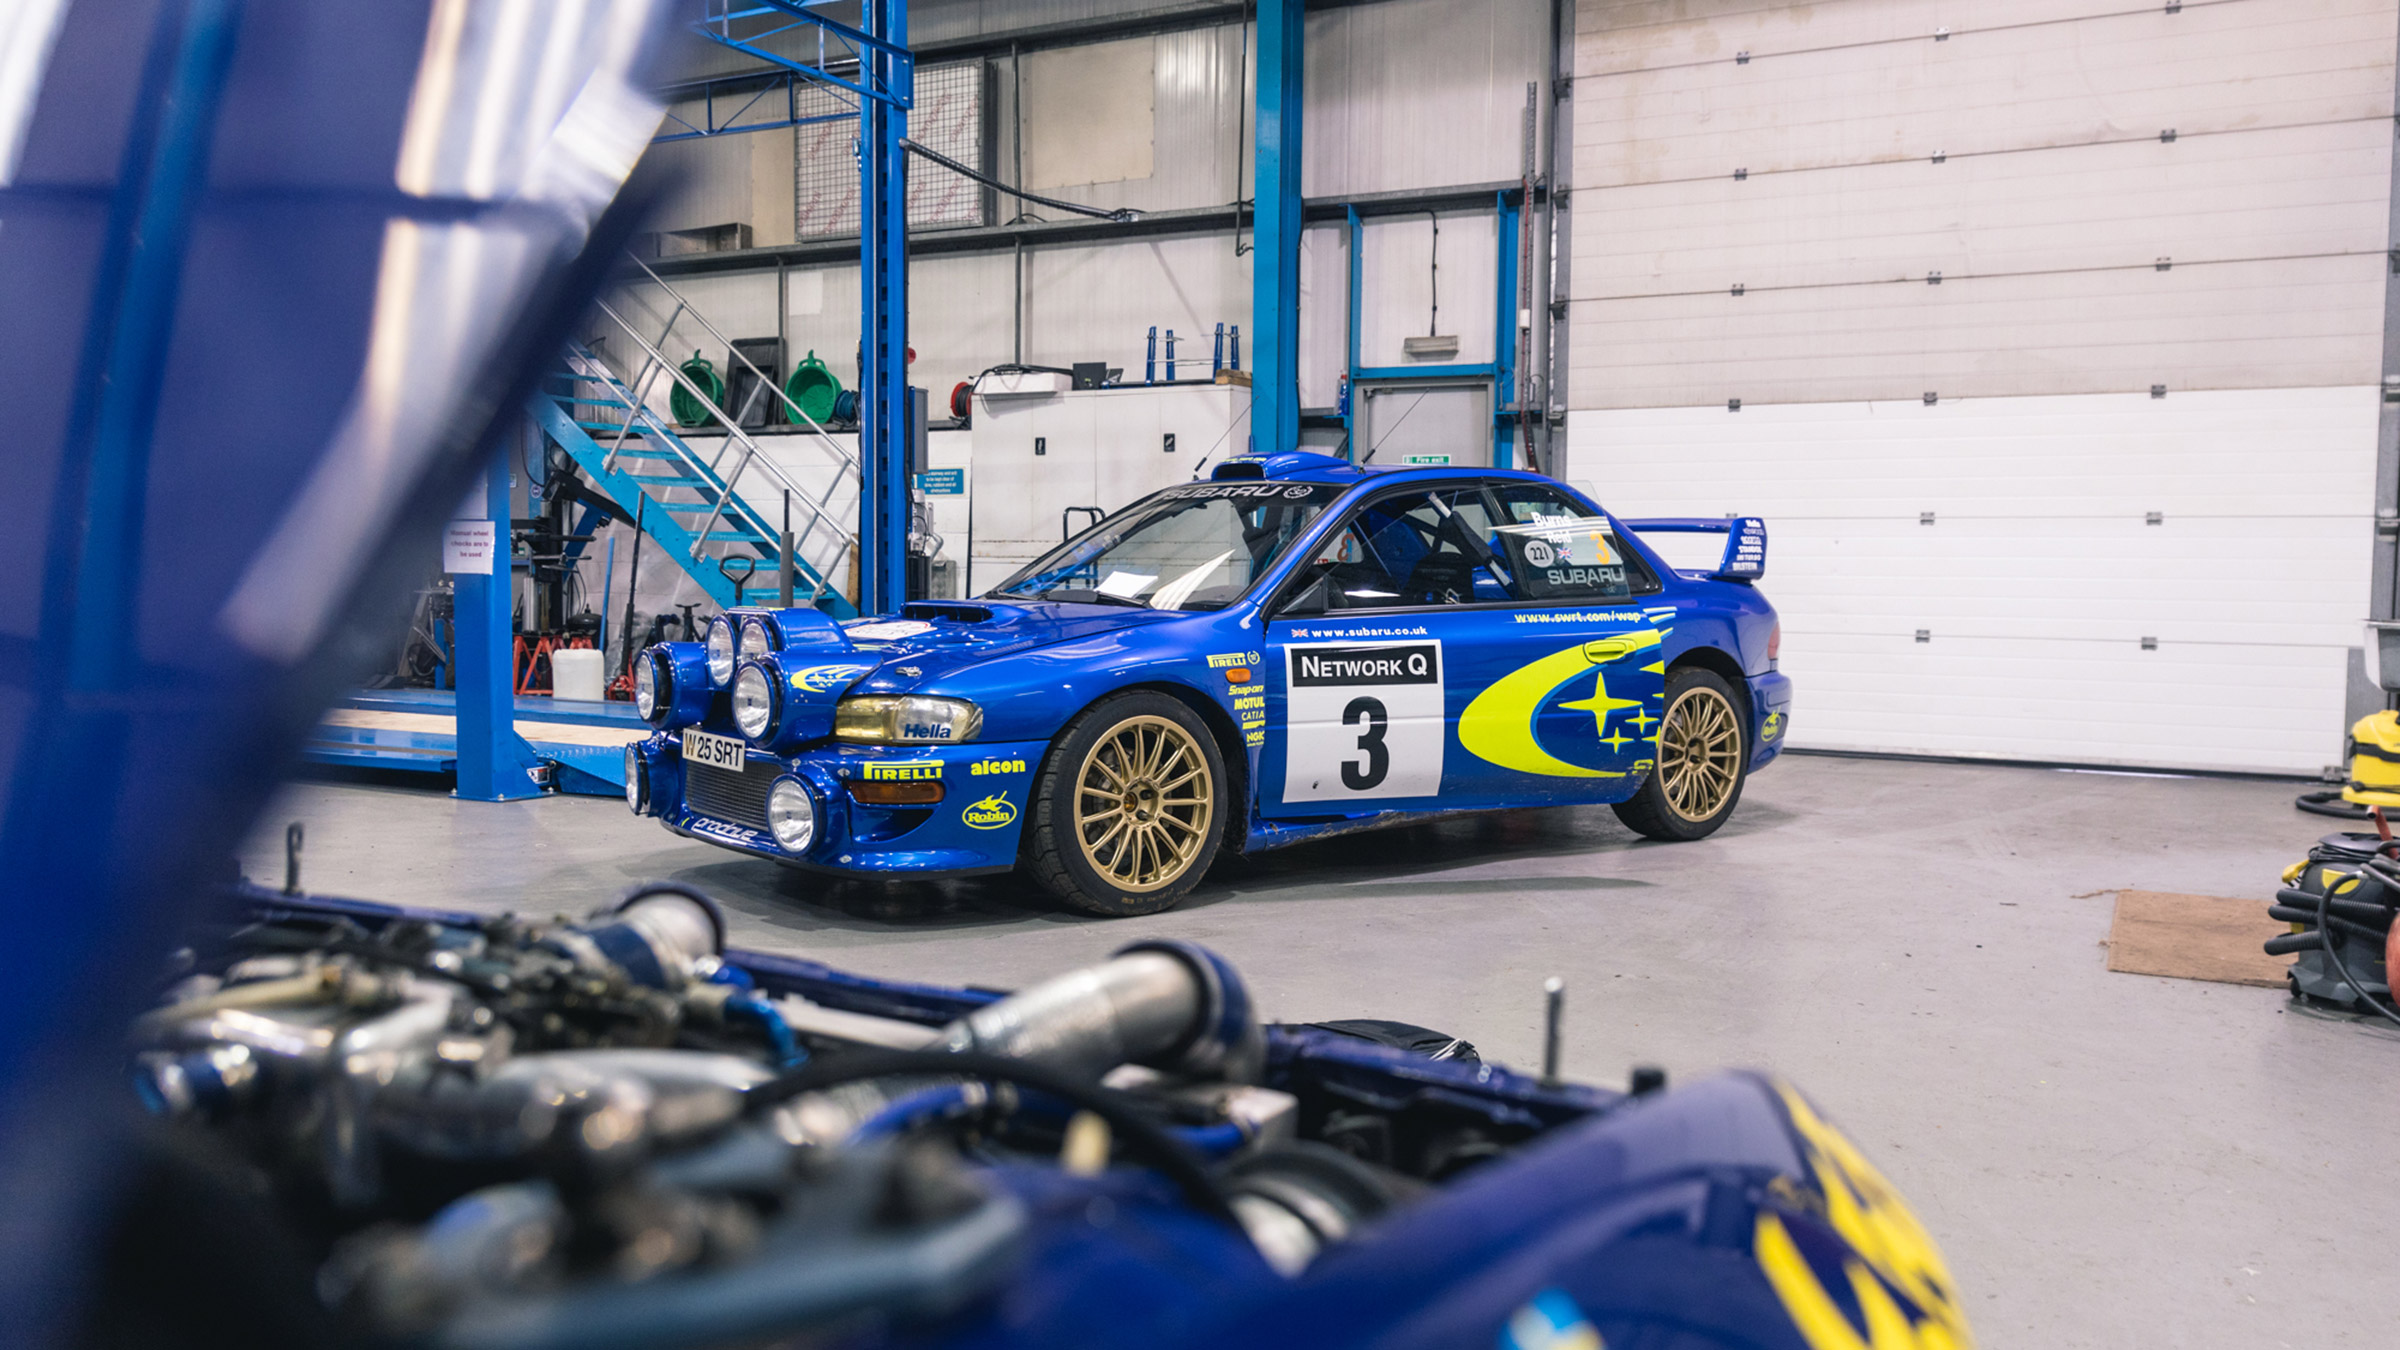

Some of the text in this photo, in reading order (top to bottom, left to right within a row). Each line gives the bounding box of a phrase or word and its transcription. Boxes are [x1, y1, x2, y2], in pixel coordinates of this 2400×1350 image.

[1163, 485, 1284, 500] SUBARU
[1530, 511, 1573, 527] Burns
[1530, 547, 1550, 560] 221
[1589, 530, 1610, 565] 3
[1547, 567, 1625, 585] SUBARU
[1514, 610, 1641, 623] www.swrt.com/wap
[1311, 626, 1428, 637] www.subaru.co.uk
[1206, 652, 1247, 668] PIRELLI
[1407, 653, 1428, 676] Q
[1228, 685, 1264, 696] Snap-on
[1234, 696, 1265, 710] MOTUL
[1241, 710, 1264, 721] CATIA
[904, 723, 951, 739] Hella
[1246, 730, 1265, 742] NGK
[1341, 696, 1389, 791] 3
[714, 740, 743, 767] SRT
[863, 759, 945, 780] PIRELLI
[970, 760, 1026, 776] alcon
[967, 810, 1010, 823] Robin
